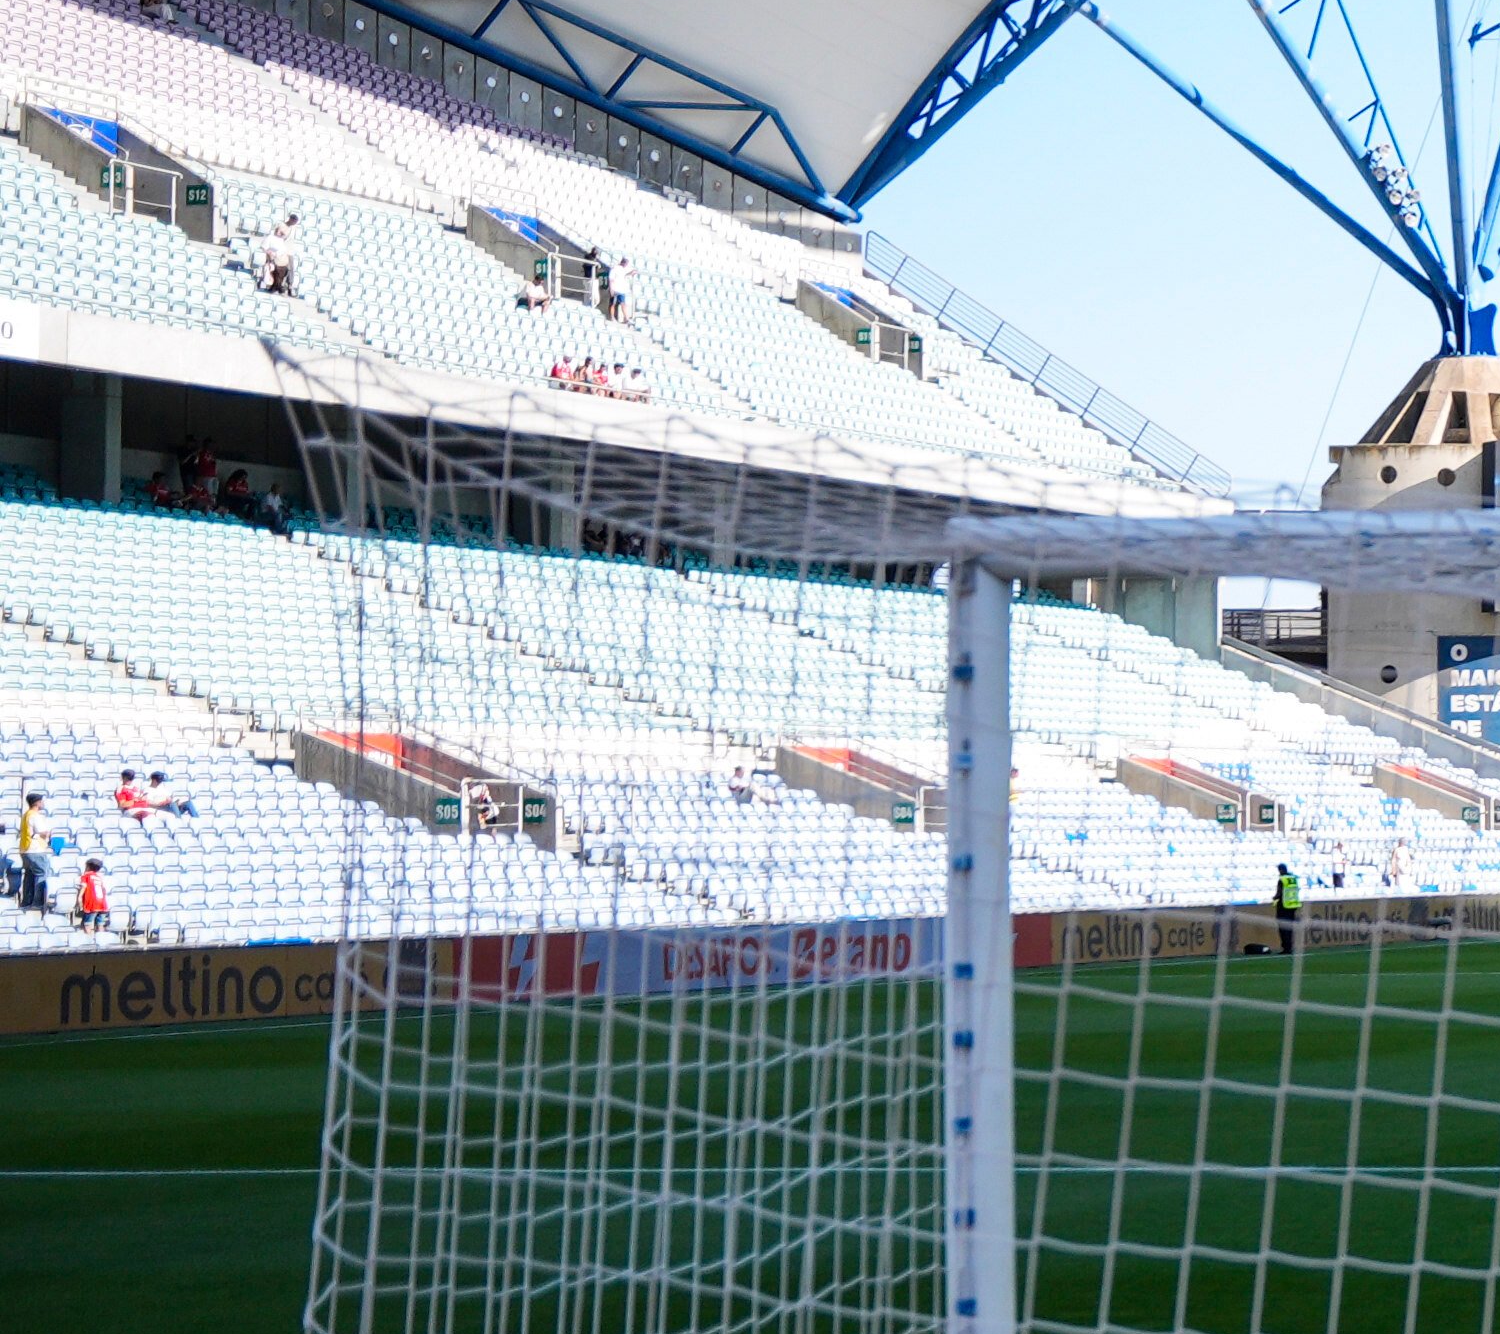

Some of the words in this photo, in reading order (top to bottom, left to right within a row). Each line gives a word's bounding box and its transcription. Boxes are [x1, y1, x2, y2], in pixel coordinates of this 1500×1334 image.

[102, 171, 121, 184] S3
[188, 189, 207, 201] S12
[1450, 644, 1468, 662] O
[435, 802, 459, 819] S05
[60, 953, 284, 1025] meltino
